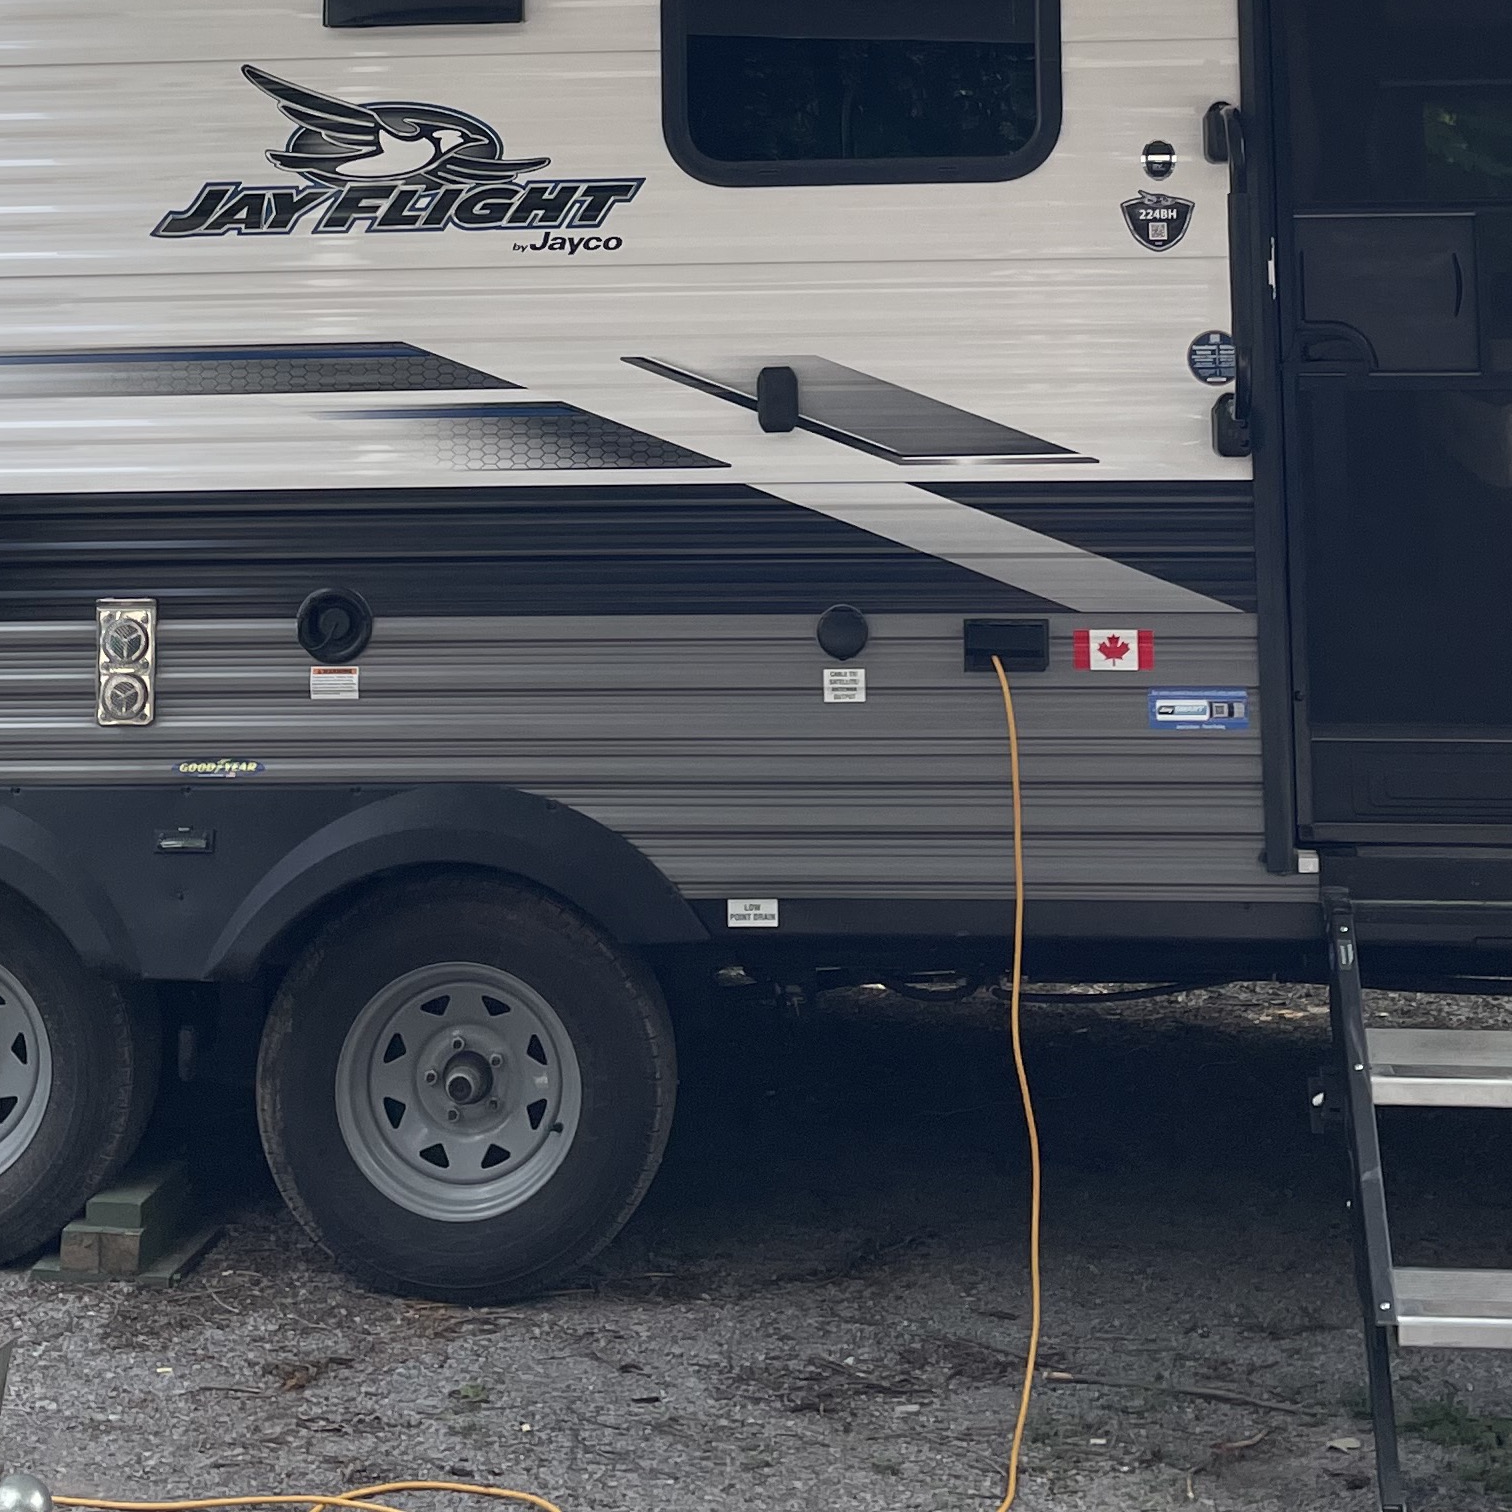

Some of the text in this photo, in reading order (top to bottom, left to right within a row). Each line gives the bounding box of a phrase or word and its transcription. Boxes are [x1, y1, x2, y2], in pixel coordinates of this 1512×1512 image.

[312, 178, 647, 235] FLIGHT
[1138, 208, 1178, 220] 224BH
[512, 231, 623, 256] by Jayco
[179, 759, 258, 774] GOODYEAR
[743, 903, 761, 912] LOW
[729, 913, 776, 921] POINT DRAIN
